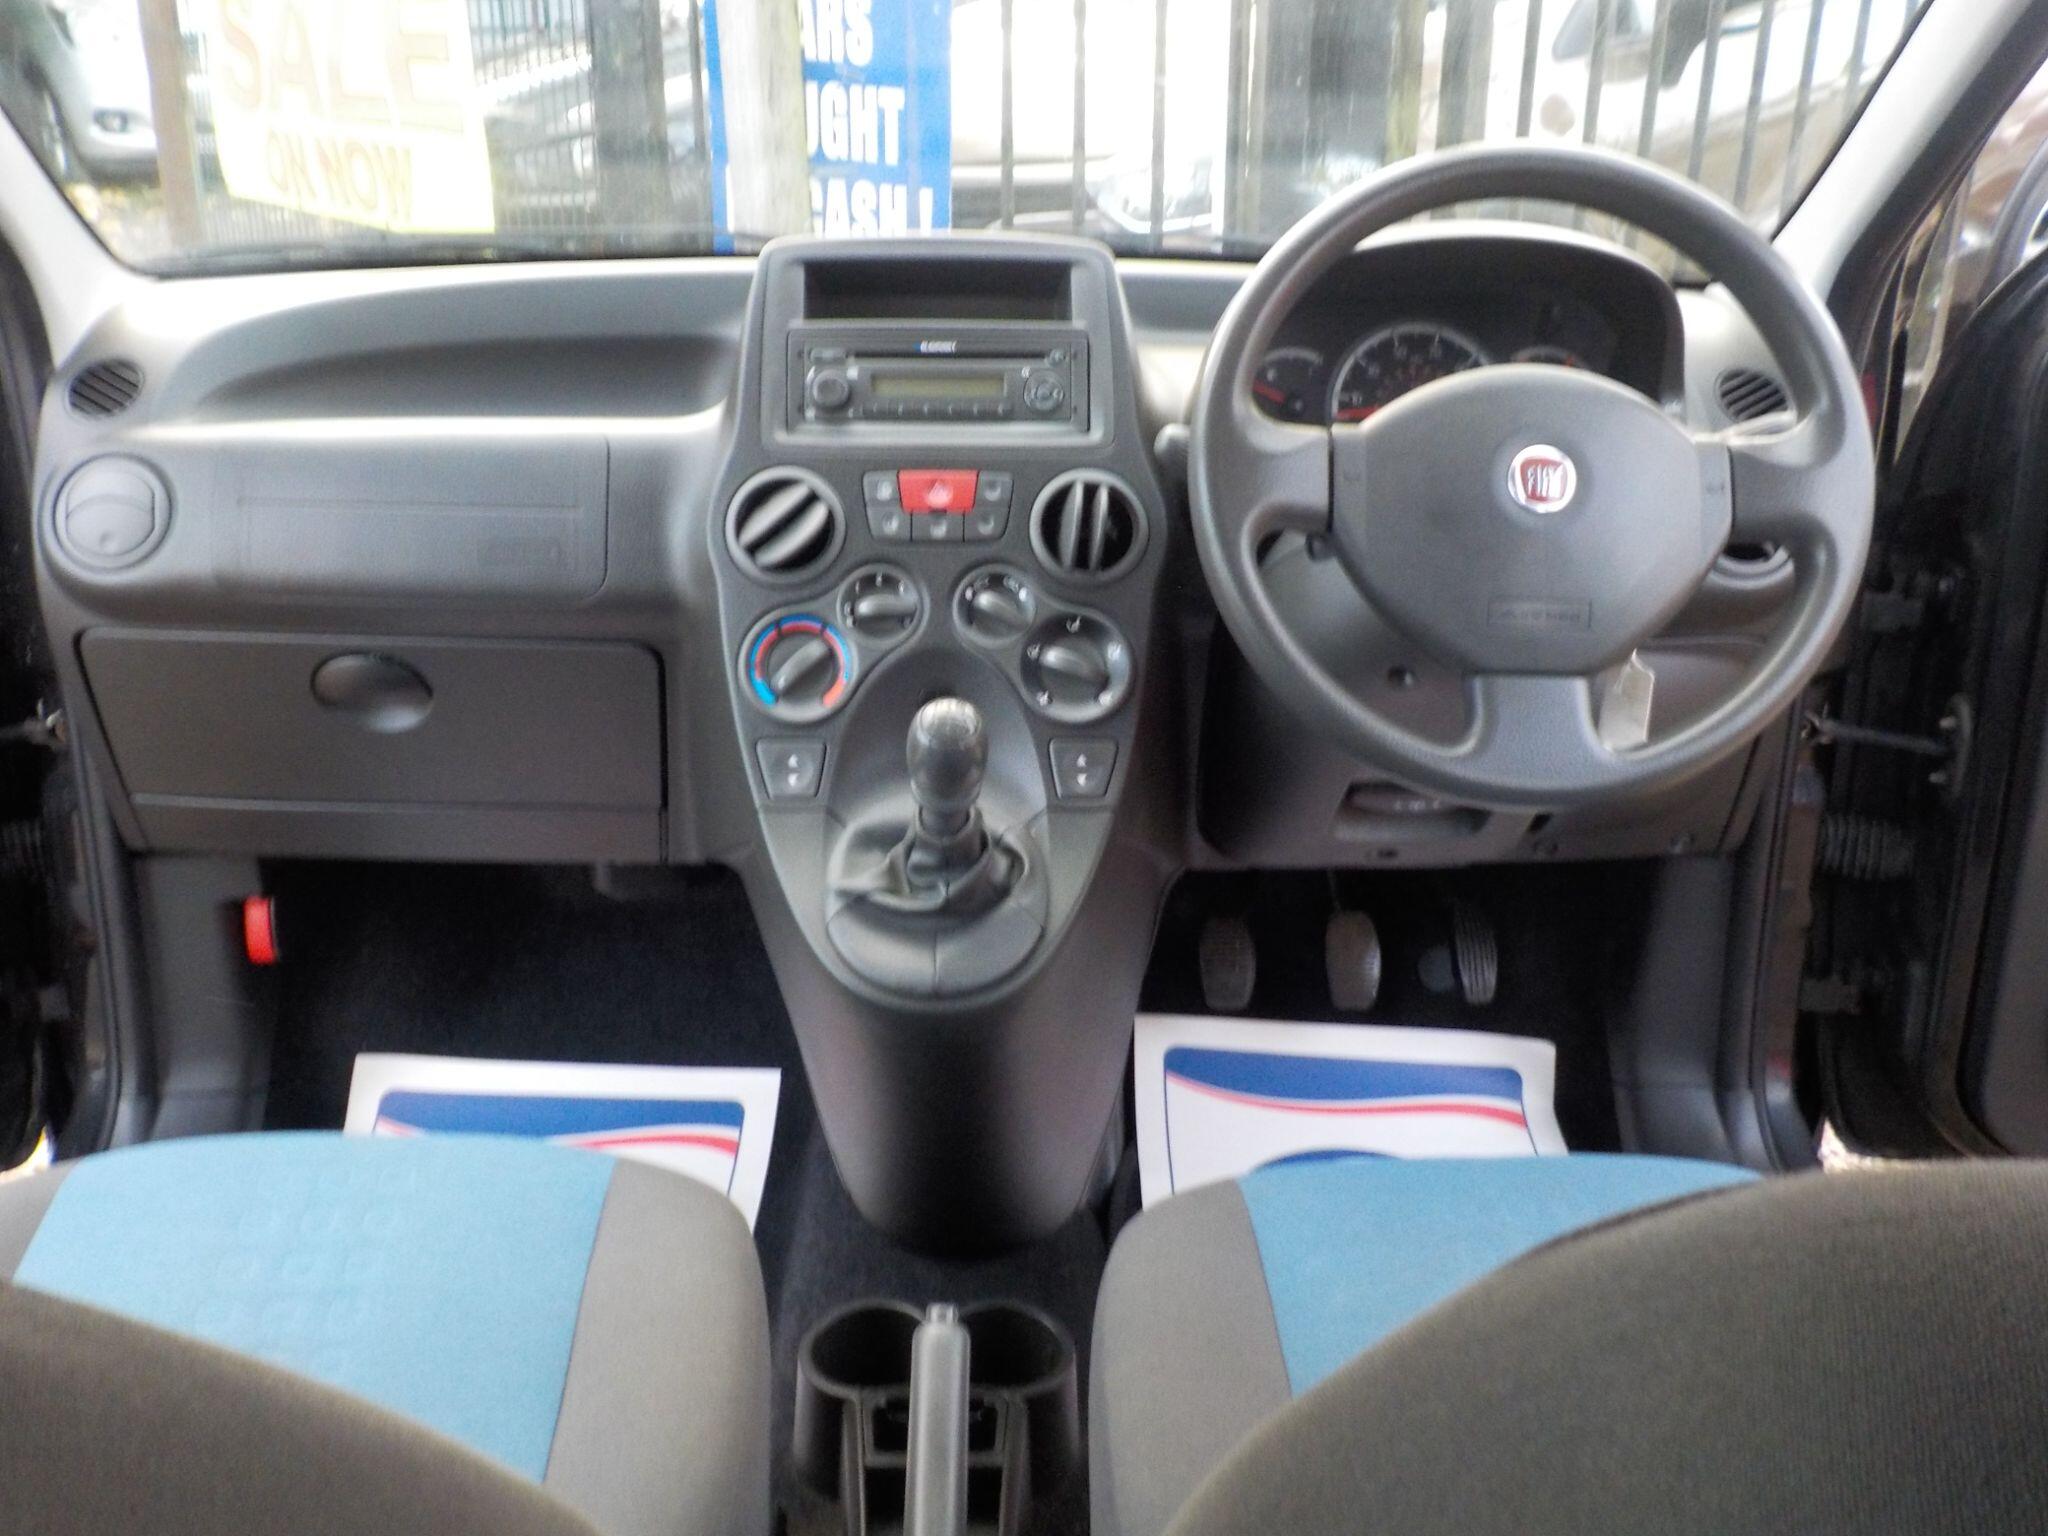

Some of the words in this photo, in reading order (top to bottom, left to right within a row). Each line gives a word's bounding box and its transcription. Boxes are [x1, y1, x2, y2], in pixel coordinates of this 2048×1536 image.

[218, 0, 464, 135] SALE
[800, 0, 873, 66] ARS
[266, 126, 317, 199] ON
[314, 134, 412, 223] NOW
